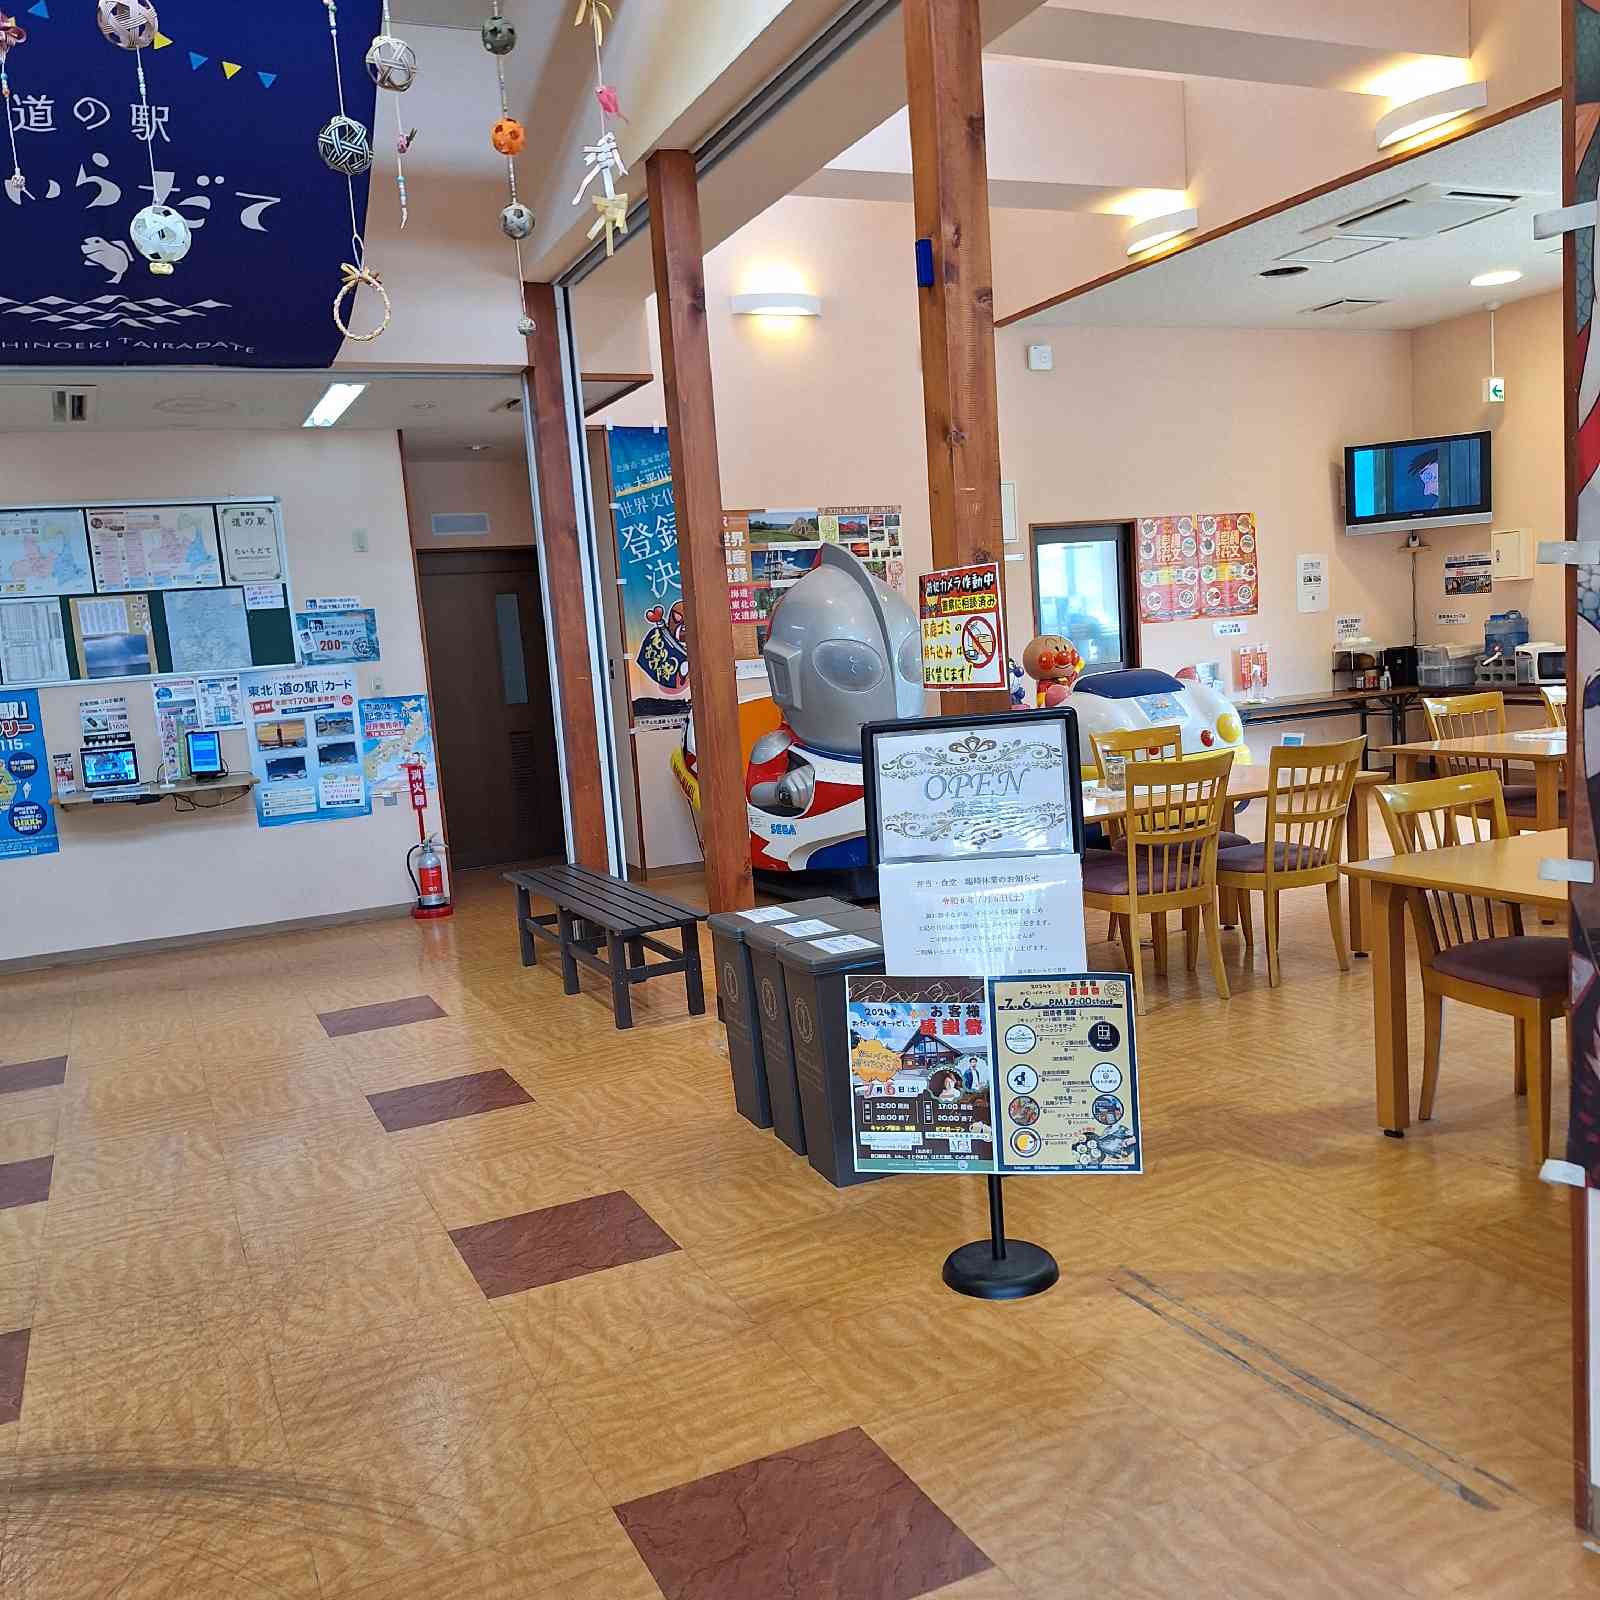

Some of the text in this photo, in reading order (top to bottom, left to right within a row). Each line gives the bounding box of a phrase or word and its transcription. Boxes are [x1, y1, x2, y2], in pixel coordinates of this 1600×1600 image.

[12, 94, 171, 143] 道の駅
[119, 337, 256, 354] TAIRADATE
[320, 639, 341, 651] 200
[247, 679, 353, 698] 東北「道の駅」カード
[924, 768, 1031, 801] OPEN
[770, 823, 797, 836] SEGA
[864, 1004, 981, 1018] 2024年 お客様
